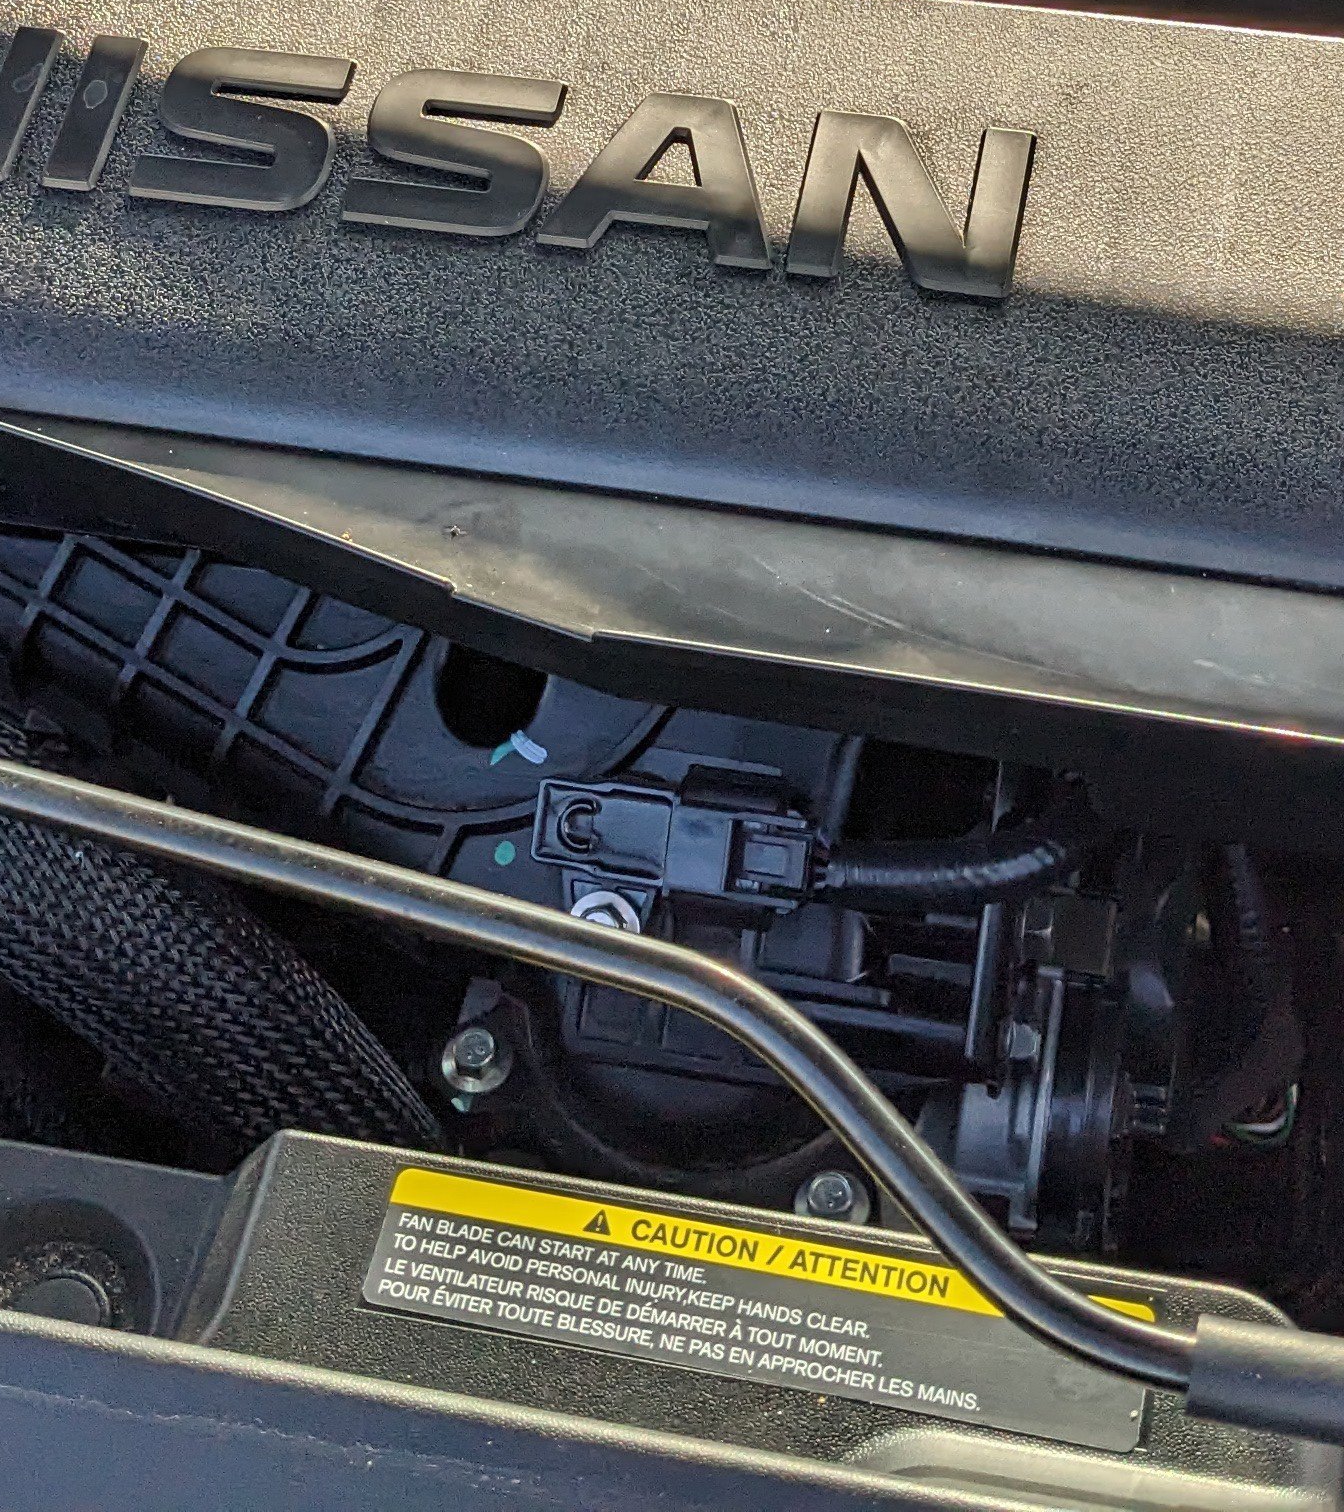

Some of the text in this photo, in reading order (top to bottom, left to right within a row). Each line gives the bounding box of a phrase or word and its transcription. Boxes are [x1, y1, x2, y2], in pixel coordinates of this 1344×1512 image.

[393, 1232, 417, 1251] TO
[419, 1238, 467, 1259] HELP
[467, 1248, 523, 1271] AVOID
[525, 1258, 621, 1291] PERSONAL
[737, 1298, 803, 1325] HANDS
[806, 1312, 870, 1338] CLEAR.
[398, 1212, 707, 1284] FAN BLADE CAN START AT ANY TIME.
[631, 1219, 950, 1298] CAUTION / ATTENTION
[377, 1279, 981, 1412] POUR ÉVITER TOUTE BLESSURE, NE PAS EN APPROCHER LES MAINS.
[384, 1257, 884, 1368] LE VENTILATEUR RISQUE DE DÉMARRER À TOUT MOMENT.
